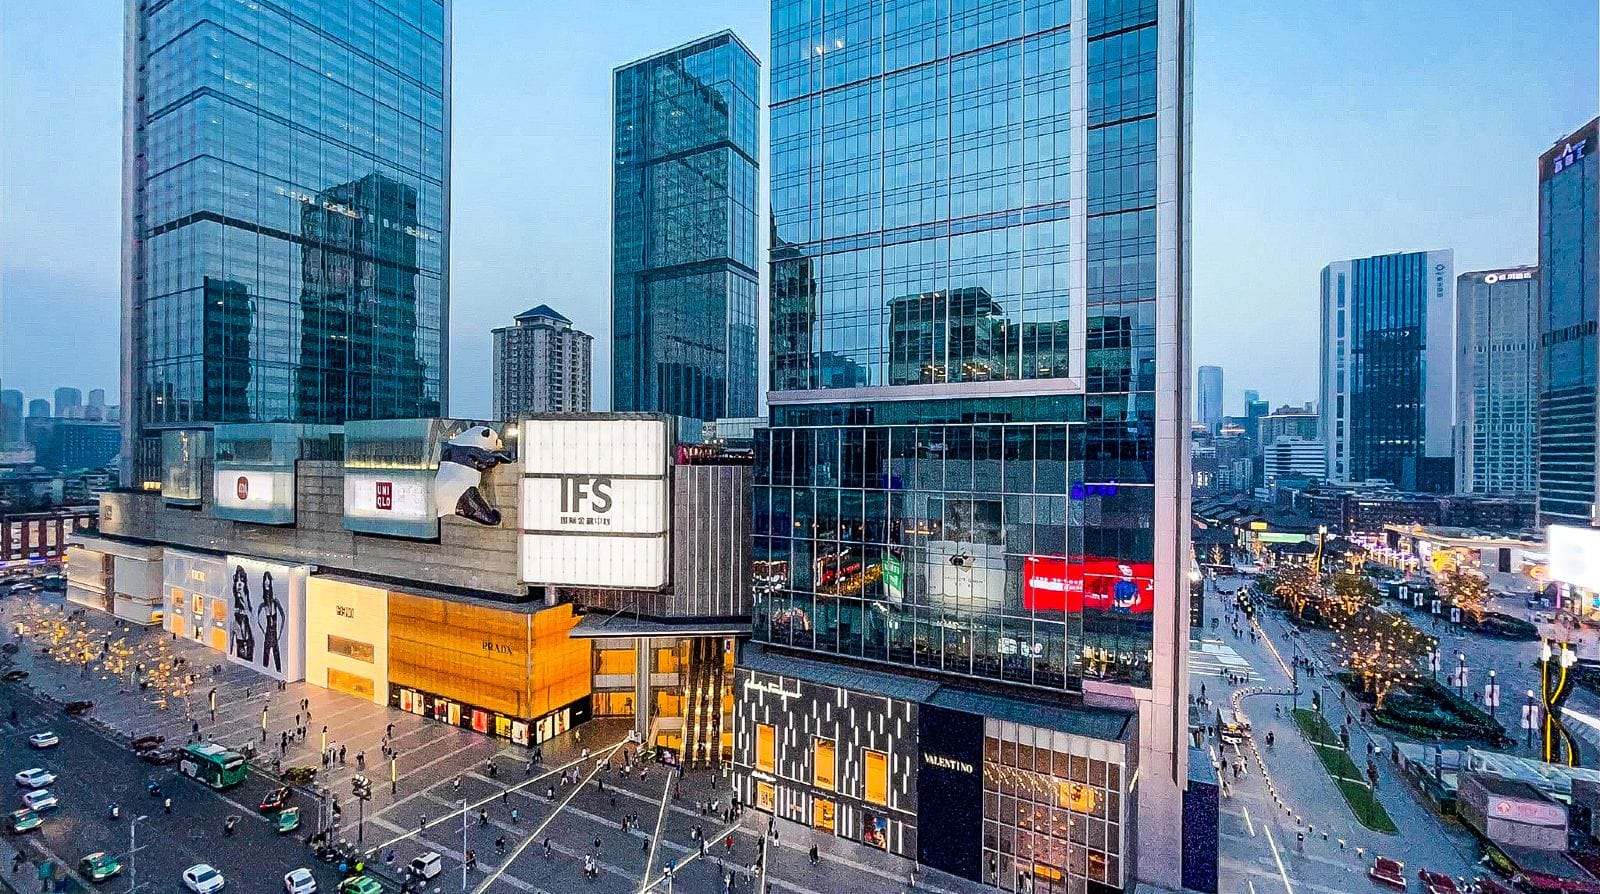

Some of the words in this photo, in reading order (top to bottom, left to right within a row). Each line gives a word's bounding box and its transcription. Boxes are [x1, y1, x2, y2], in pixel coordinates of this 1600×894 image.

[377, 485, 390, 496] UNI
[561, 476, 612, 513] IFS
[377, 496, 391, 508] QLO
[482, 641, 513, 655] PRADA
[924, 752, 973, 774] VALENTINO
